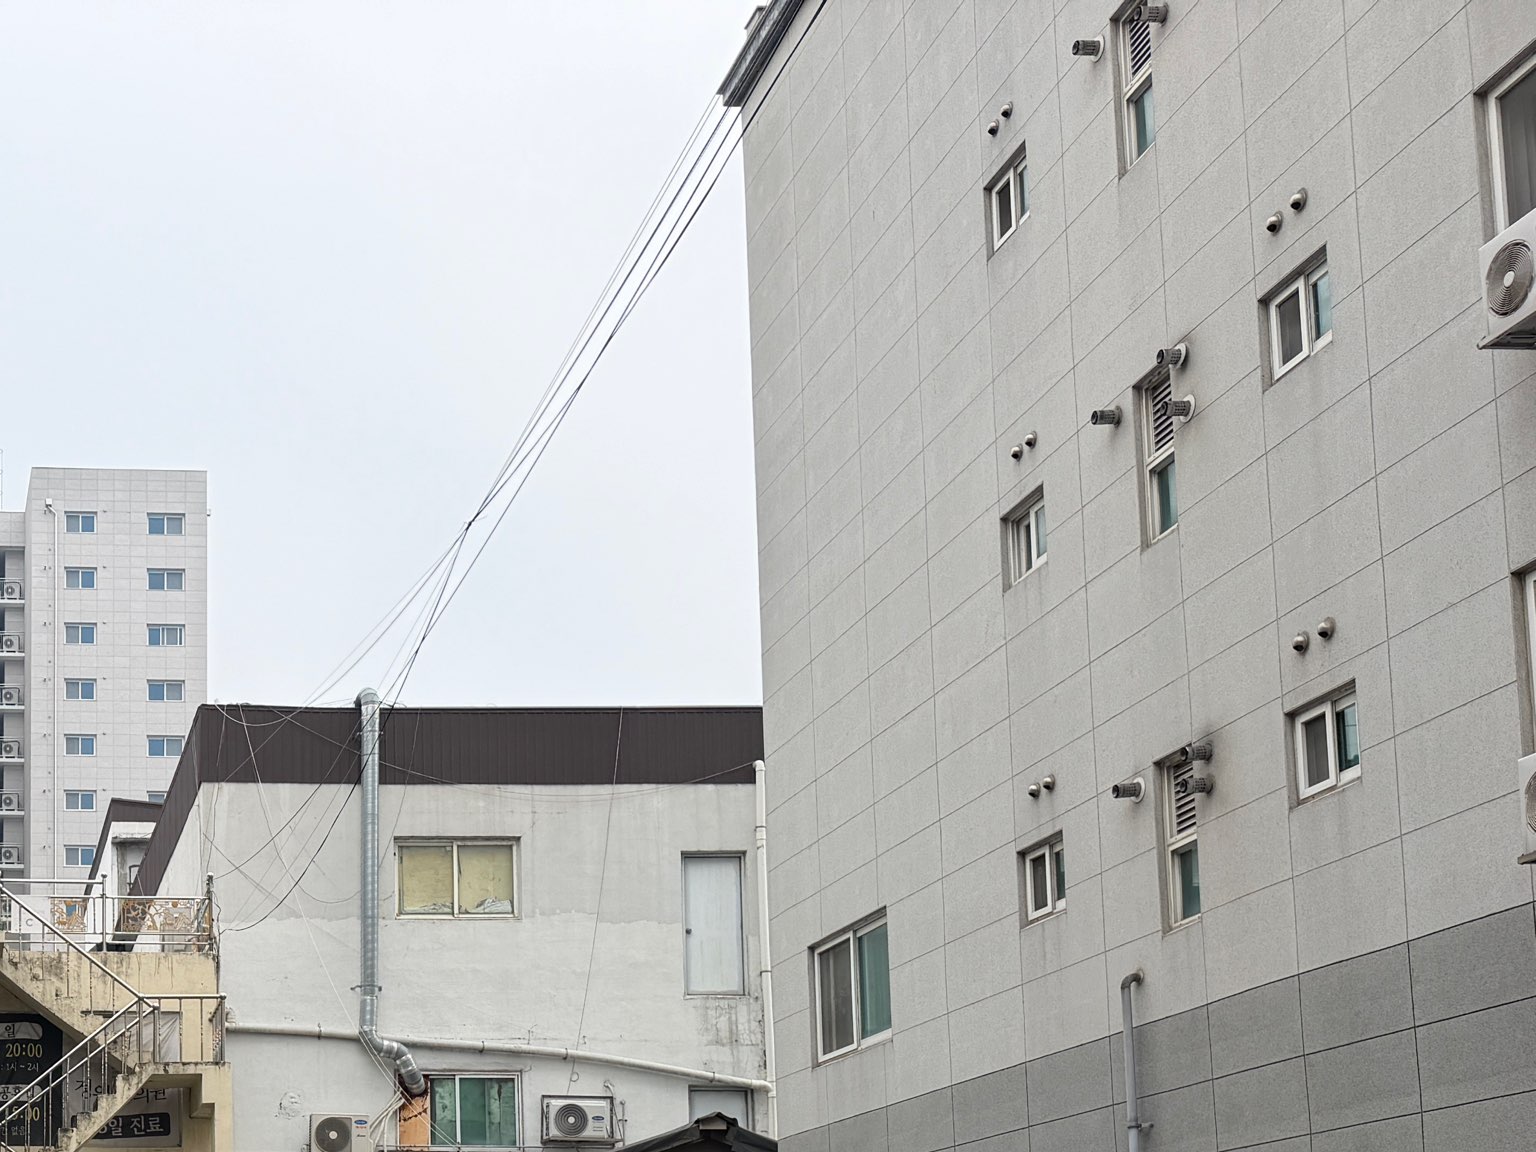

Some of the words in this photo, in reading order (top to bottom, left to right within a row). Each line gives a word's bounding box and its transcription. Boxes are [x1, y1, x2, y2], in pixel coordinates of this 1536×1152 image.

[6, 1043, 42, 1057] 20:00
[27, 1063, 38, 1072] 2시
[130, 1116, 163, 1134] 진료
